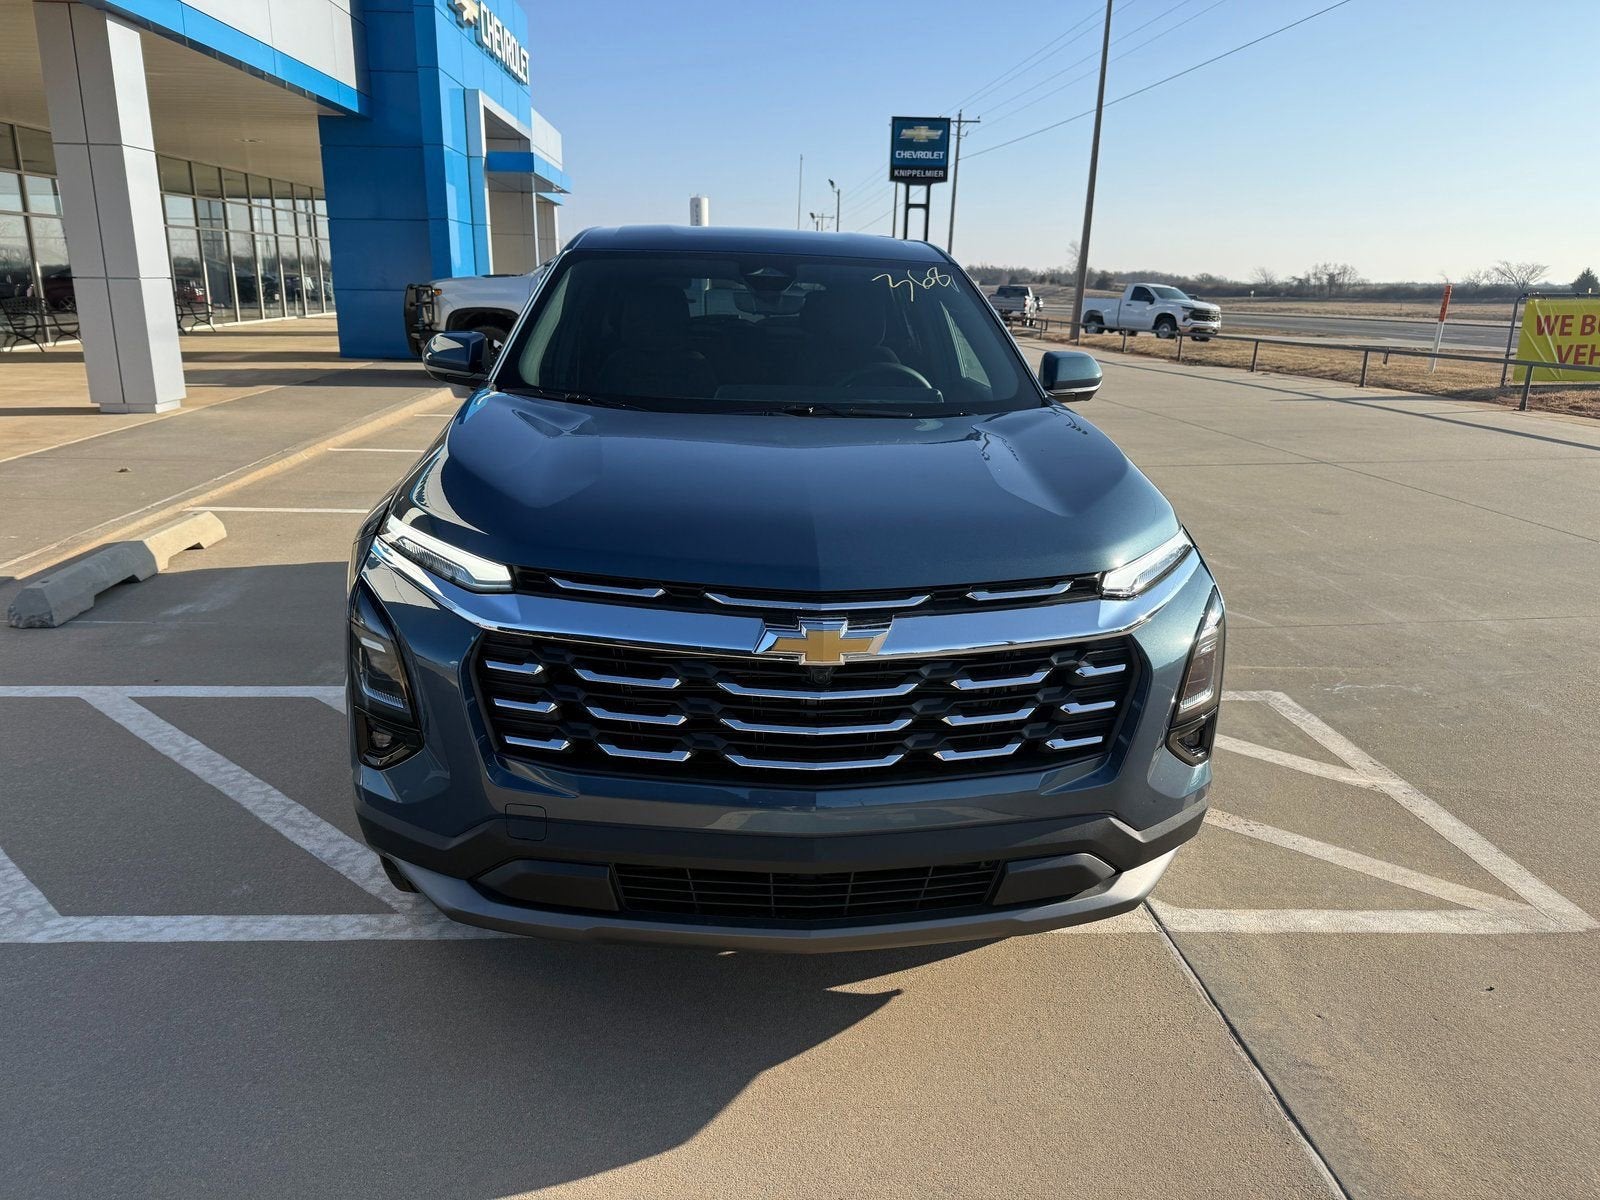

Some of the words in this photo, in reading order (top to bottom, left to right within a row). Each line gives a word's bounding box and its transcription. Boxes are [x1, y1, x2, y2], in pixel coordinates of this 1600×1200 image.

[480, 1, 529, 85] CHEVROLET
[895, 150, 944, 159] CHEVROLET
[894, 169, 944, 177] KNIPPELMIER
[1536, 315, 1574, 336] WE
[1580, 315, 1600, 336] B
